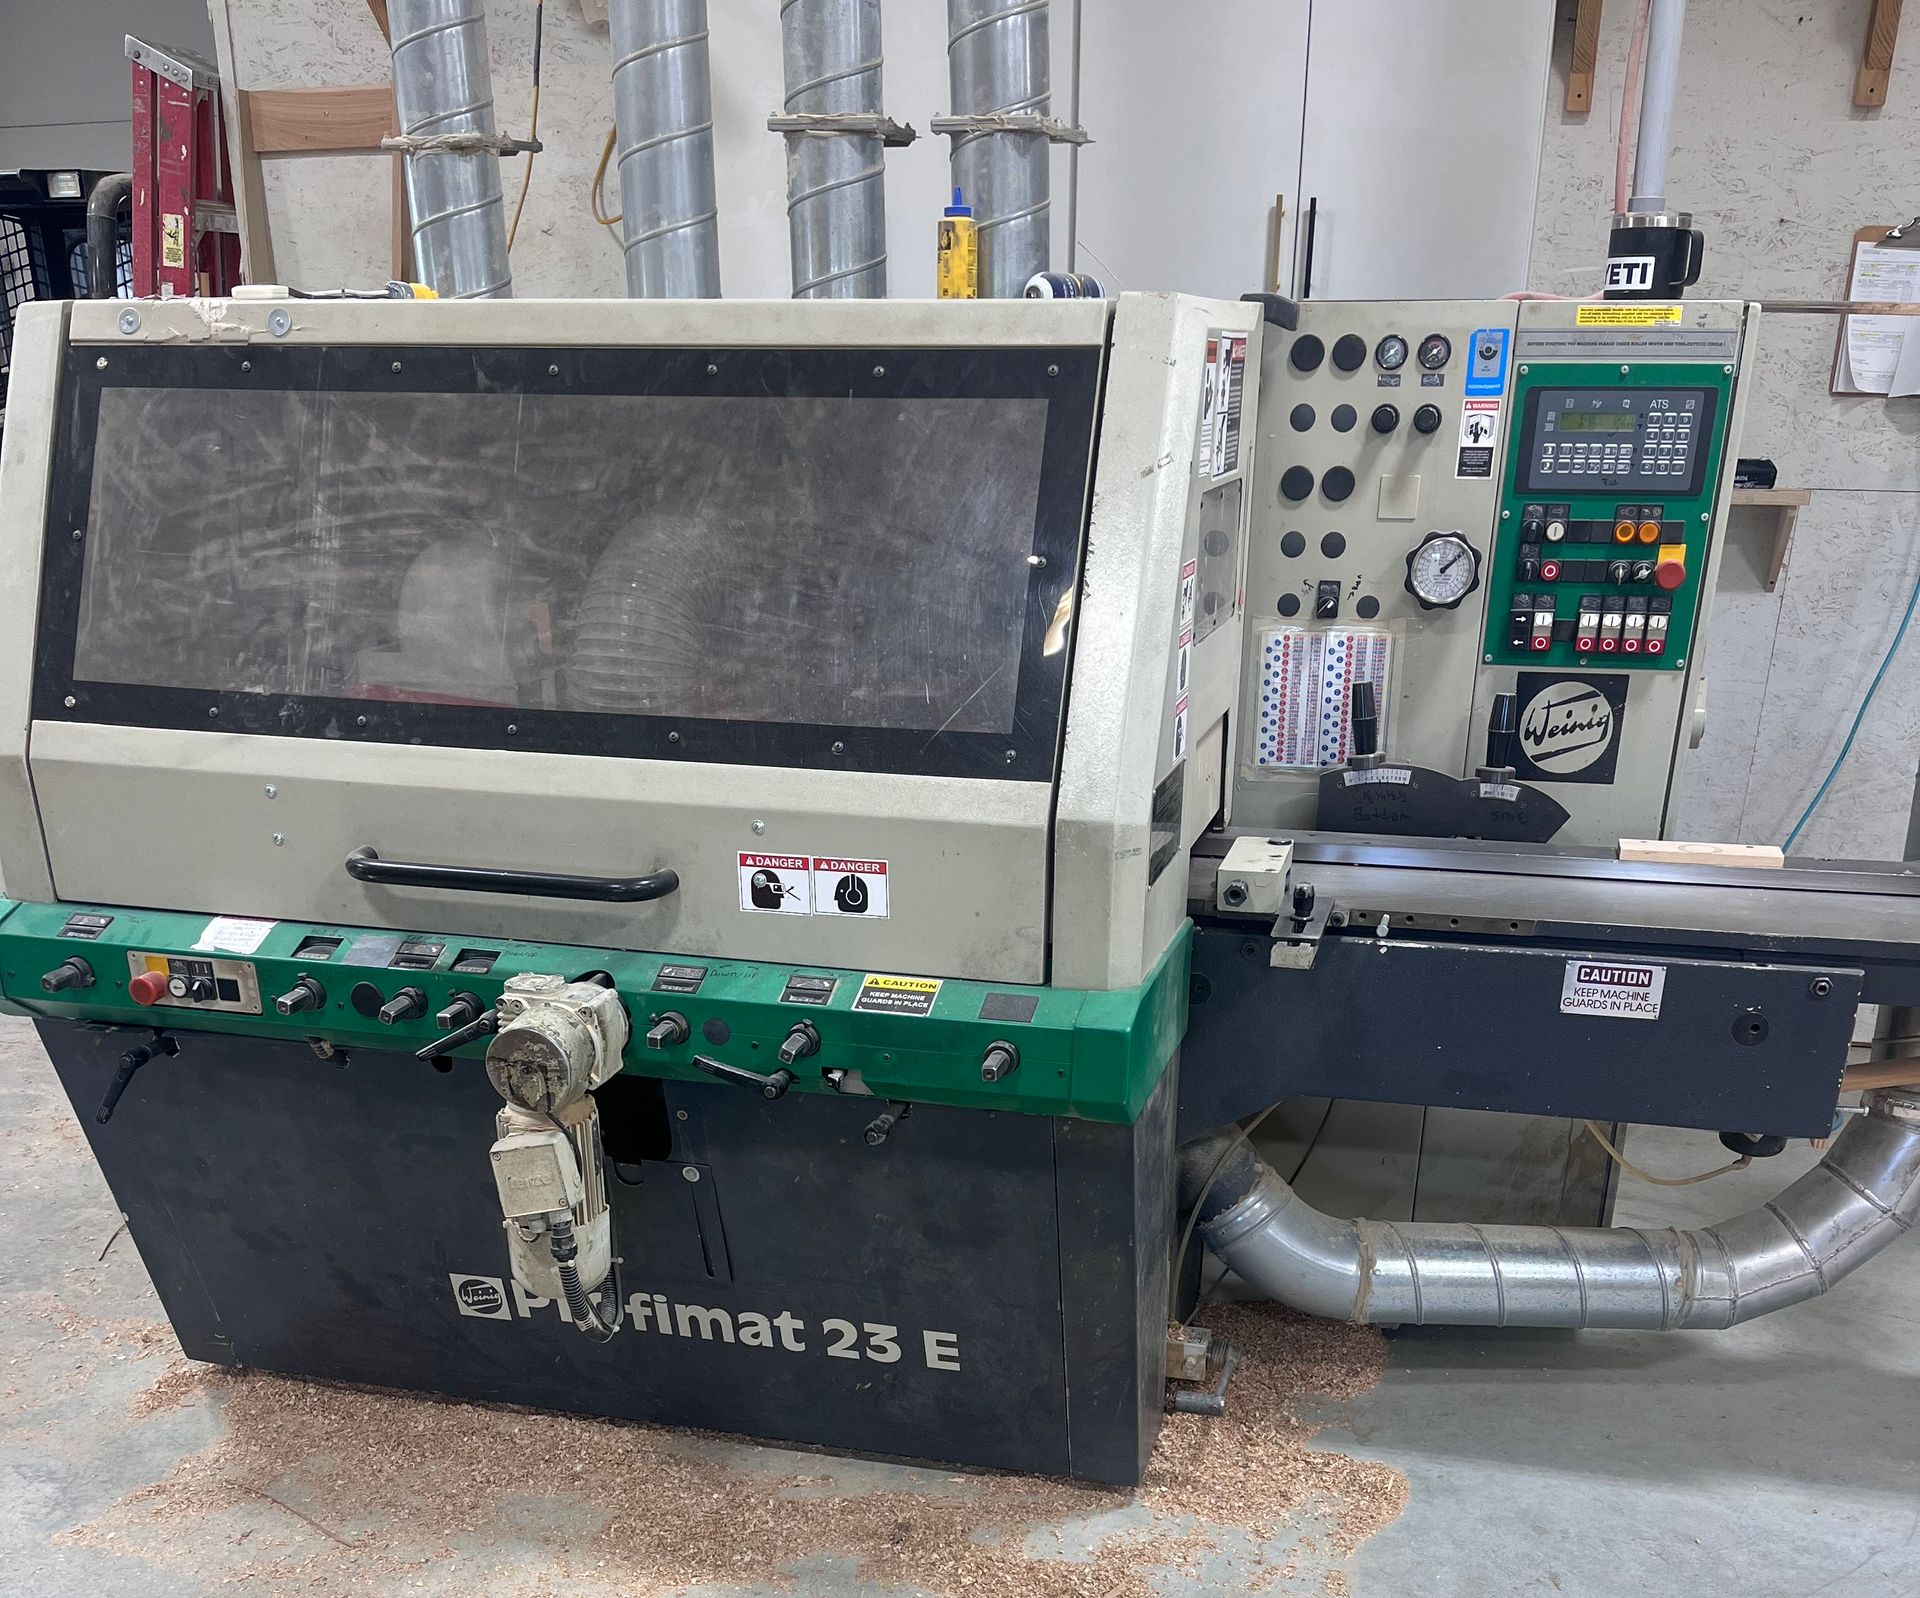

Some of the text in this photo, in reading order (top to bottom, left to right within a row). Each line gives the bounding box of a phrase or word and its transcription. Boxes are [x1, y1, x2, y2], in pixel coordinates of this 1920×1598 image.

[1650, 400, 1669, 409] ATS
[1523, 694, 1611, 758] Weinig
[756, 856, 803, 868] DANGER
[831, 862, 880, 872] DANGER
[1580, 968, 1650, 985] CAUTION
[883, 980, 937, 989] CAUTION
[861, 997, 894, 1005] GUARDS
[890, 993, 926, 1001] MACHINE
[1574, 987, 1650, 1002] KEEP MACHINE
[1562, 997, 1659, 1013] GUARDS IN PLACE
[461, 1285, 502, 1309] Weinig
[822, 1319, 903, 1363] 23
[923, 1330, 962, 1372] E
